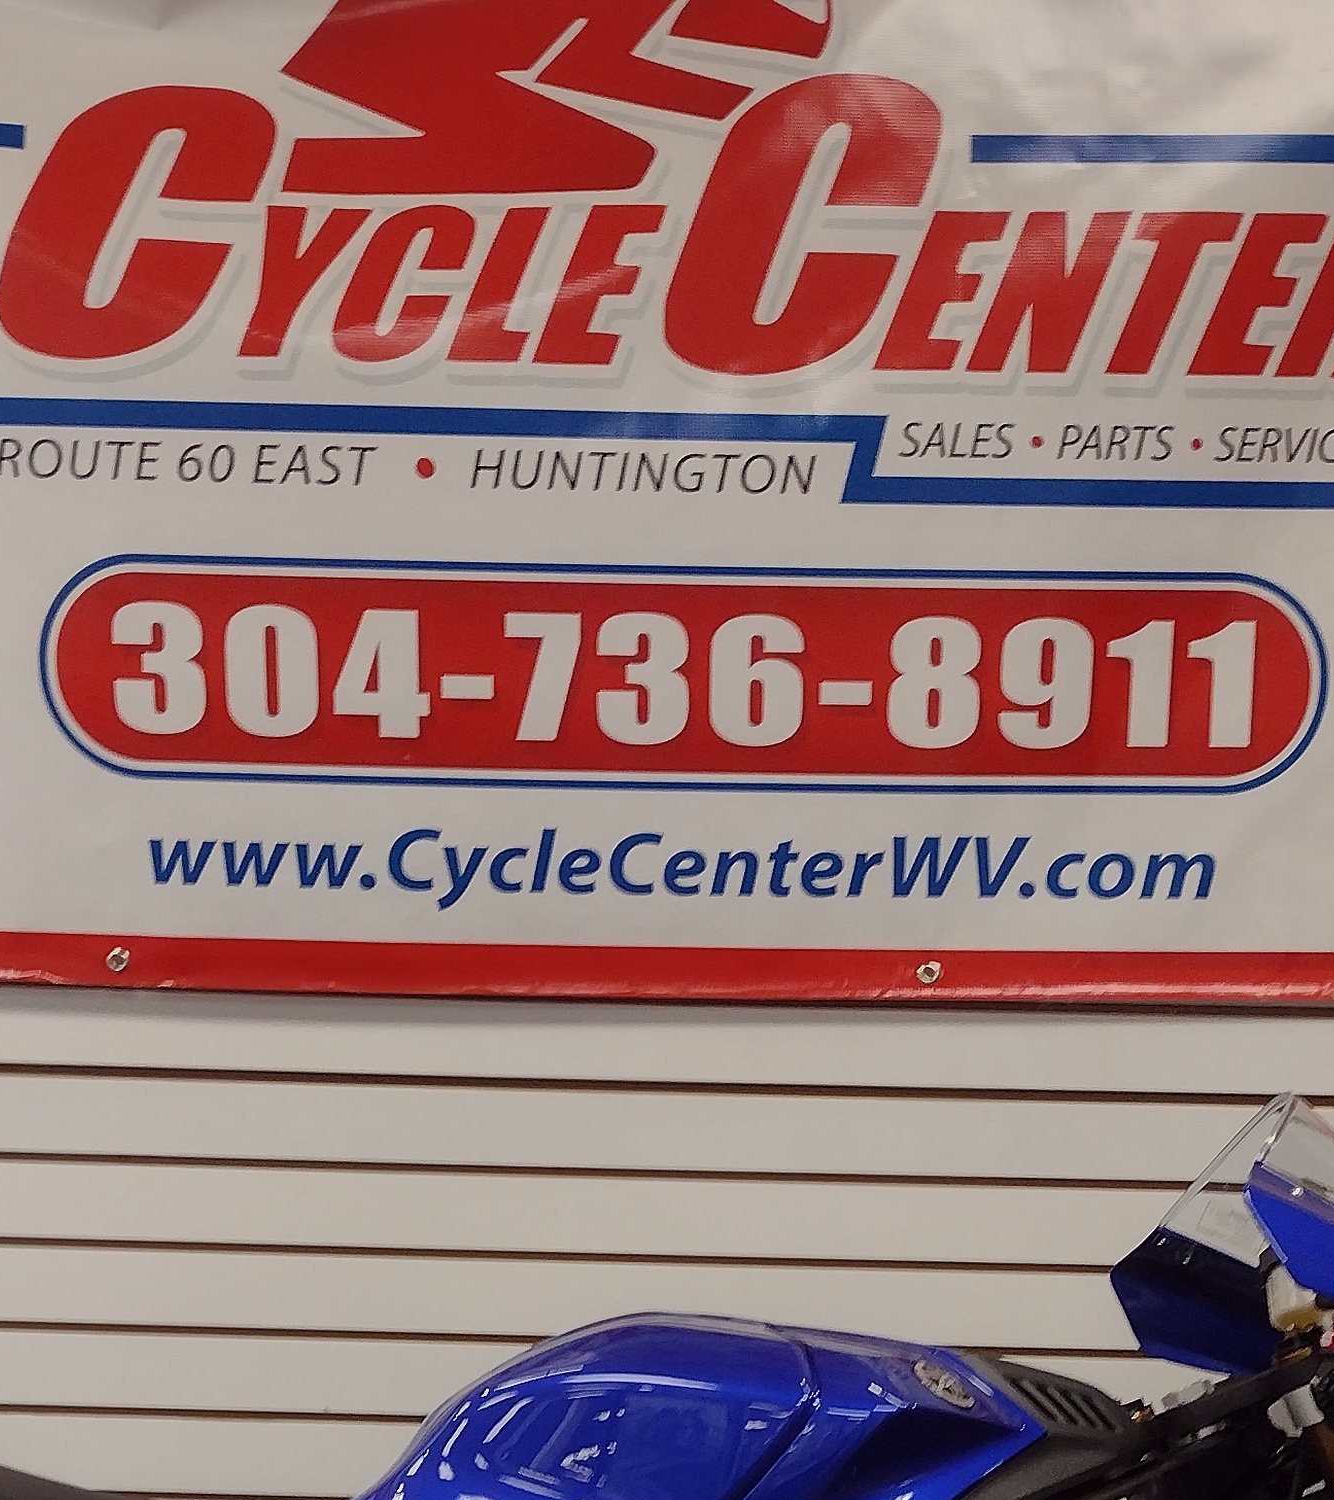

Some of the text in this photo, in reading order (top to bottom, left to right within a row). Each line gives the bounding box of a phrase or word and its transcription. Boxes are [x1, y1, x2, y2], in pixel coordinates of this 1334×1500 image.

[176, 442, 236, 484] 60
[250, 443, 379, 487] EAST
[469, 446, 818, 495] HUNTINGTON
[897, 421, 1017, 460] SALES
[1055, 423, 1177, 462] PARTS
[110, 600, 1259, 750] 304-736-8911
[149, 828, 1216, 908] www.CycleCenterWV.com
